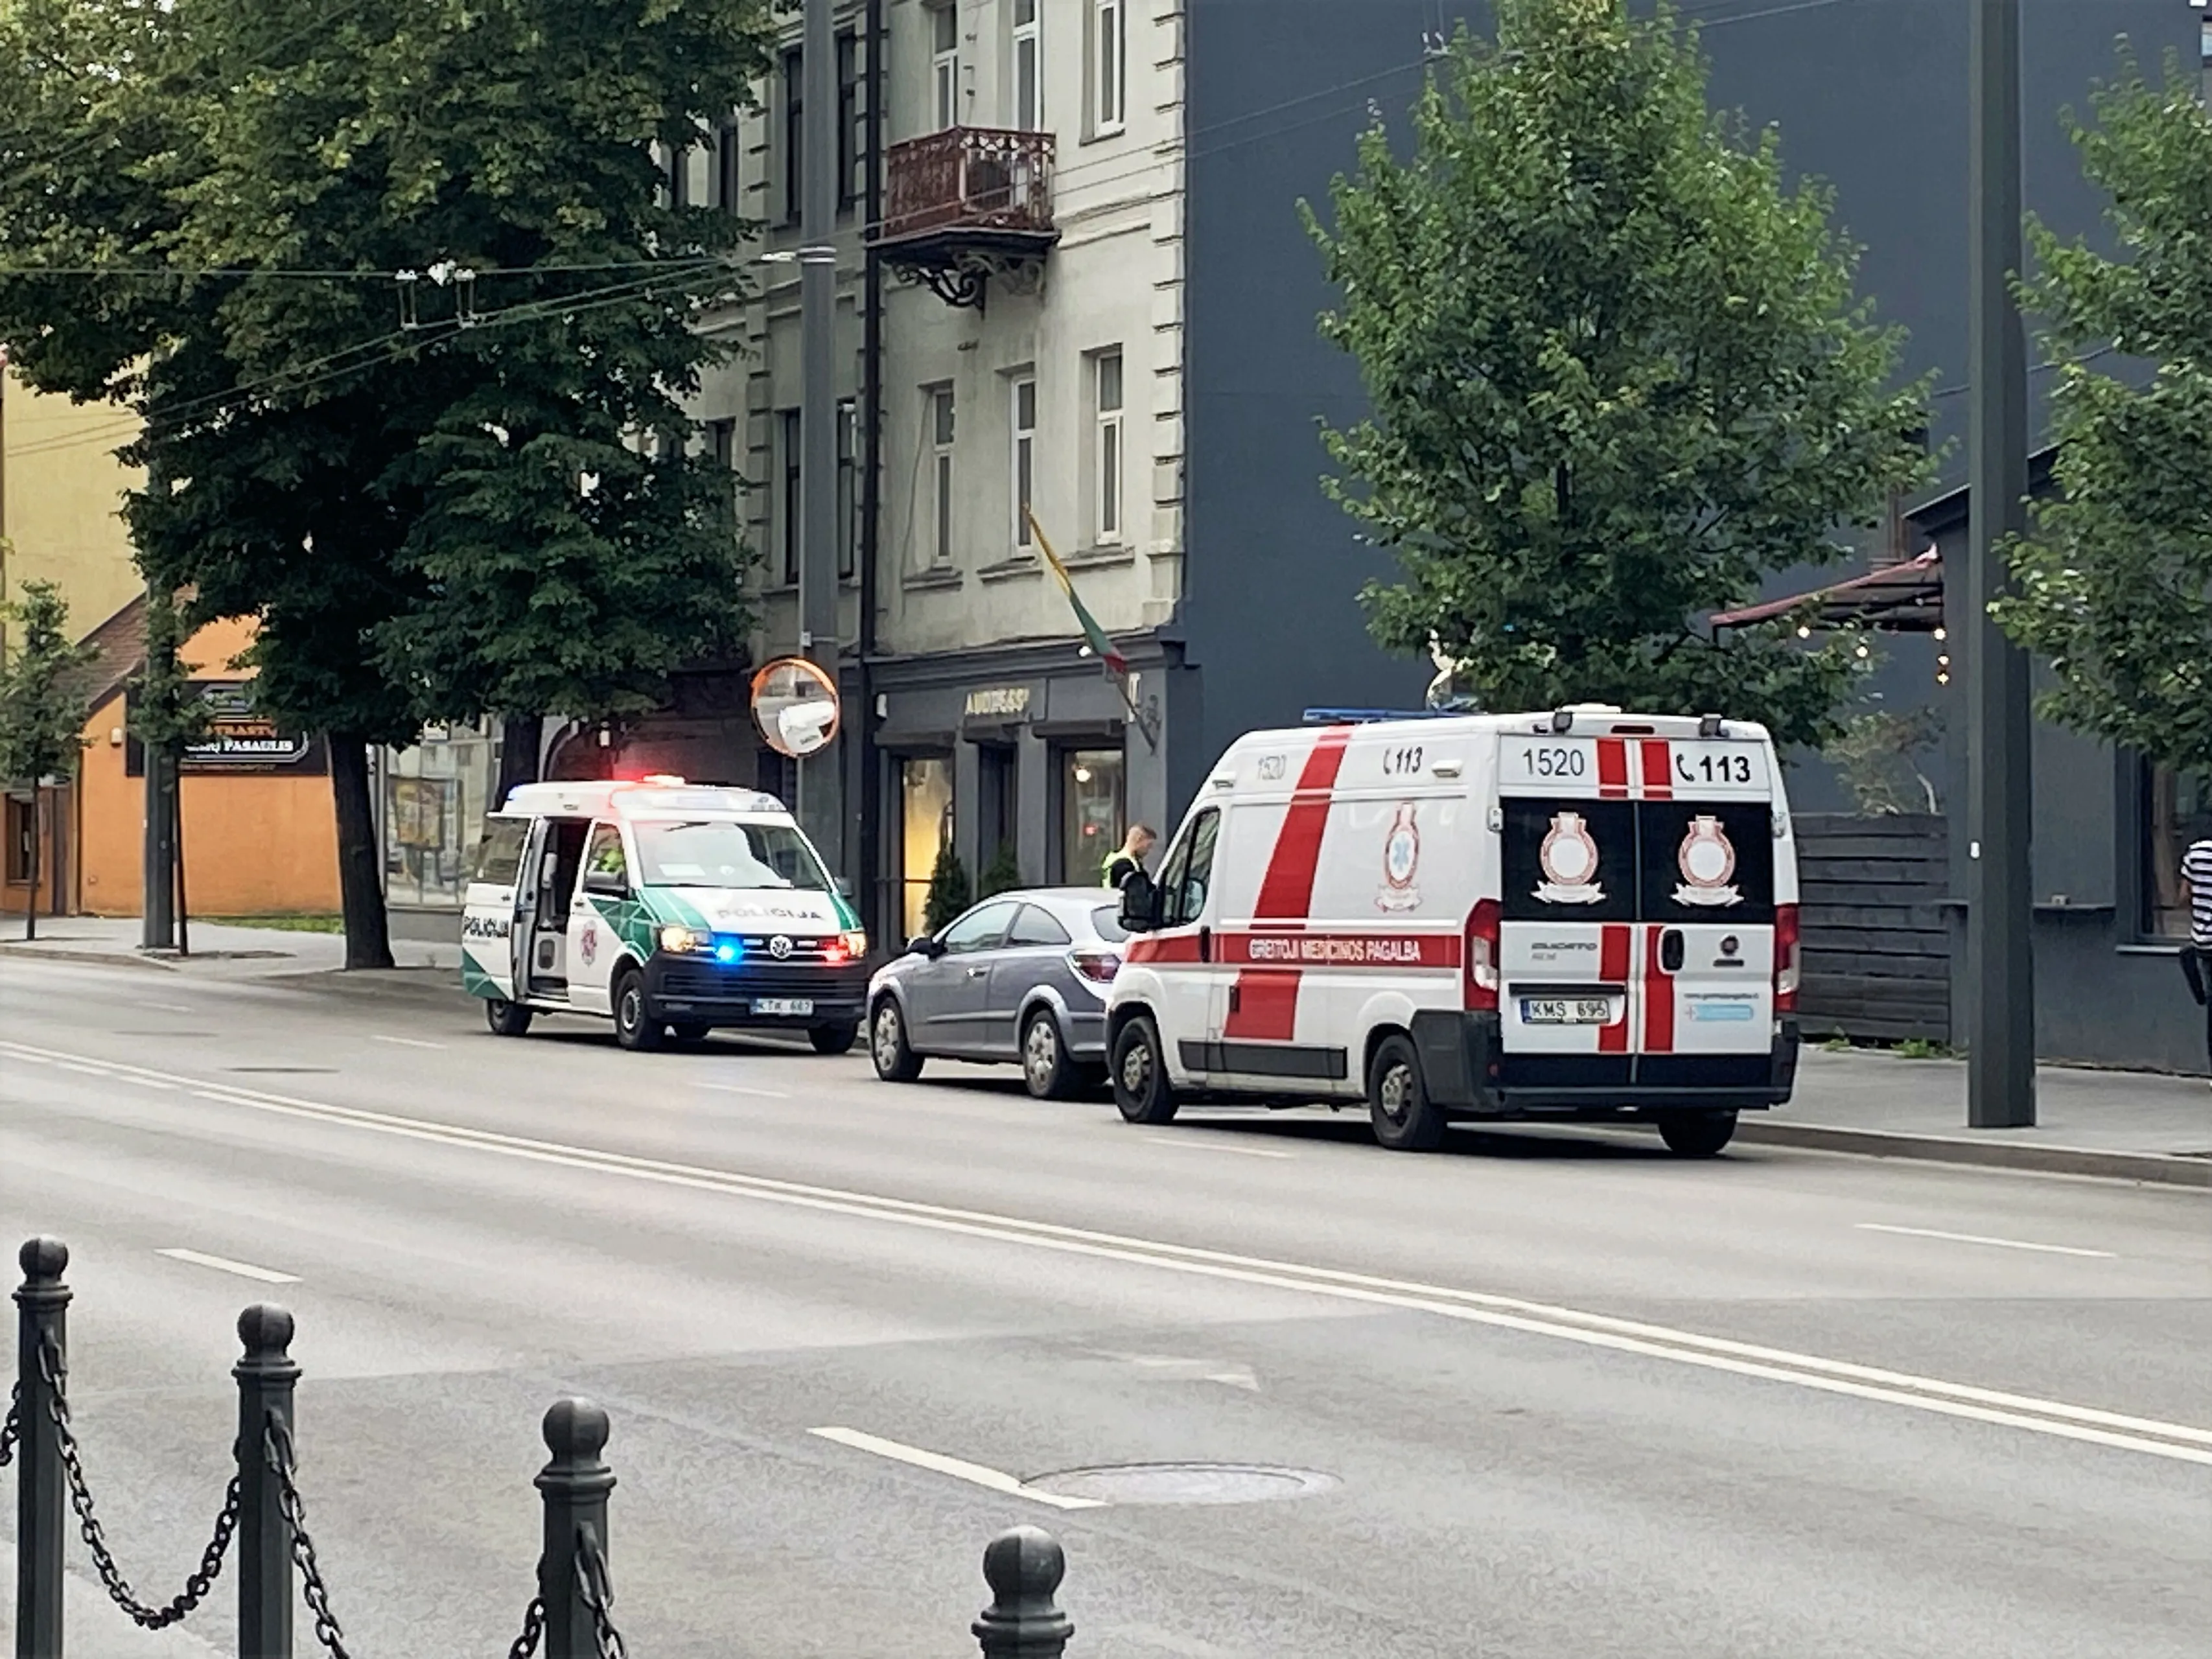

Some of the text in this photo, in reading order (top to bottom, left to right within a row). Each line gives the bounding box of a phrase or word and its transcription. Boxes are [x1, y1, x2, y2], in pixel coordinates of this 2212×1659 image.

[1396, 746, 1423, 774] 113
[1523, 748, 1584, 776] 1520
[1699, 755, 1751, 783] 113
[717, 907, 824, 922] POLICIJA
[1366, 941, 1421, 961] PAGALBA
[1531, 1002, 1566, 1017] KMS
